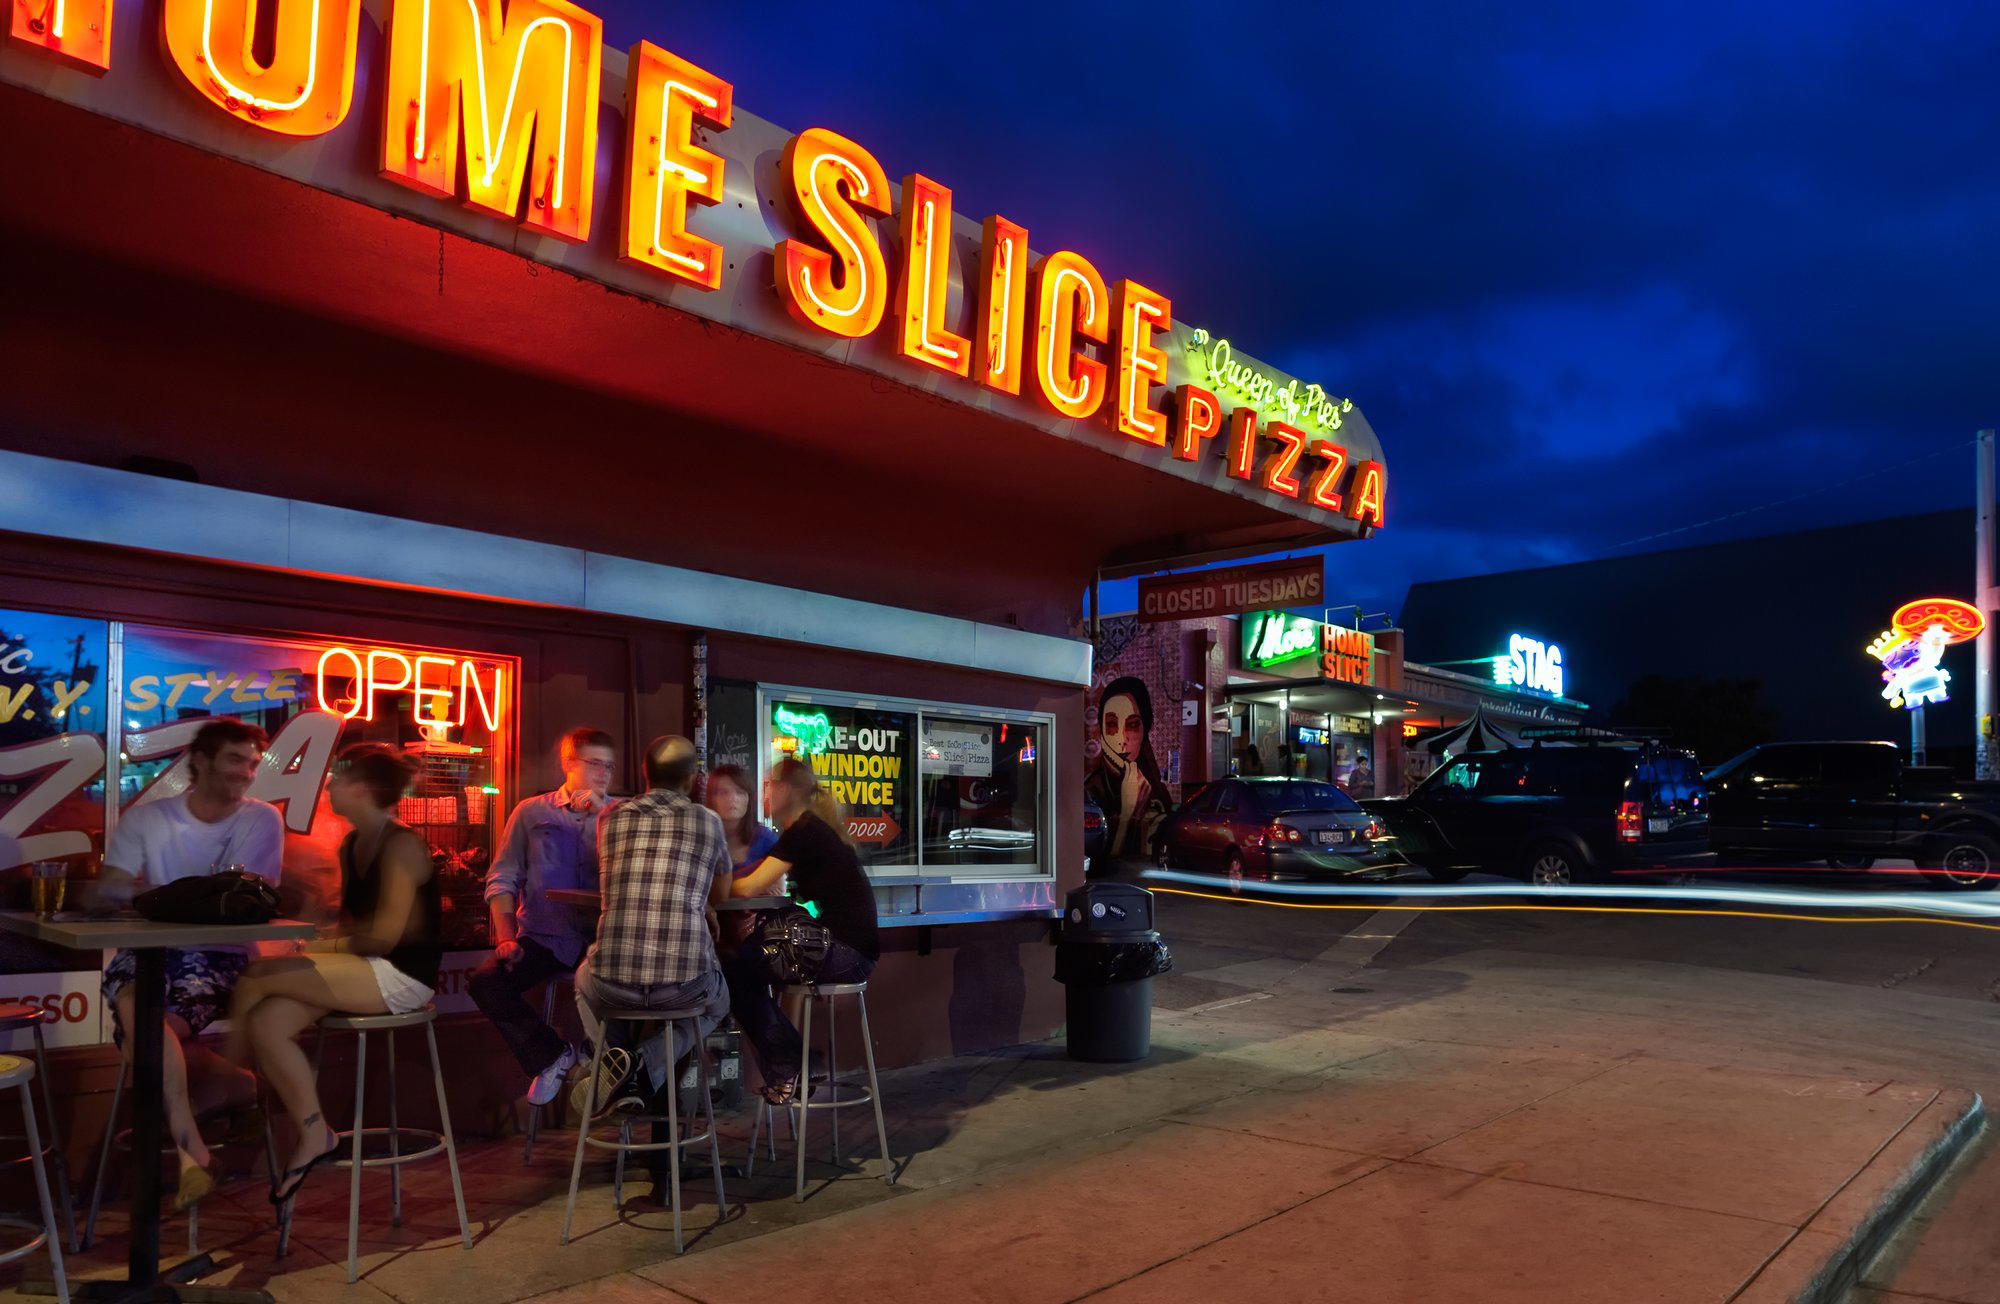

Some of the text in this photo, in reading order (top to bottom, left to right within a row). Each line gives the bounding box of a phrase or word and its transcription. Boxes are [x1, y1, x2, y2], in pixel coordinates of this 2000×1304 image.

[775, 127, 1170, 447] SLICE
[1275, 379, 1300, 426] of
[1172, 384, 1386, 529] PIZZA
[1144, 572, 1321, 615] CLOSED TUESDAYS
[1249, 611, 1316, 664] More
[1320, 624, 1372, 659] HOME
[1320, 651, 1372, 687] SLICE
[1509, 633, 1564, 698] STAG
[125, 667, 303, 712] STYLE
[317, 647, 502, 732] OPEN
[711, 723, 749, 752] More
[944, 751, 965, 762] Slice
[967, 753, 990, 764] Pizza
[811, 753, 901, 779] WINDOW
[848, 822, 887, 837] DOOR
